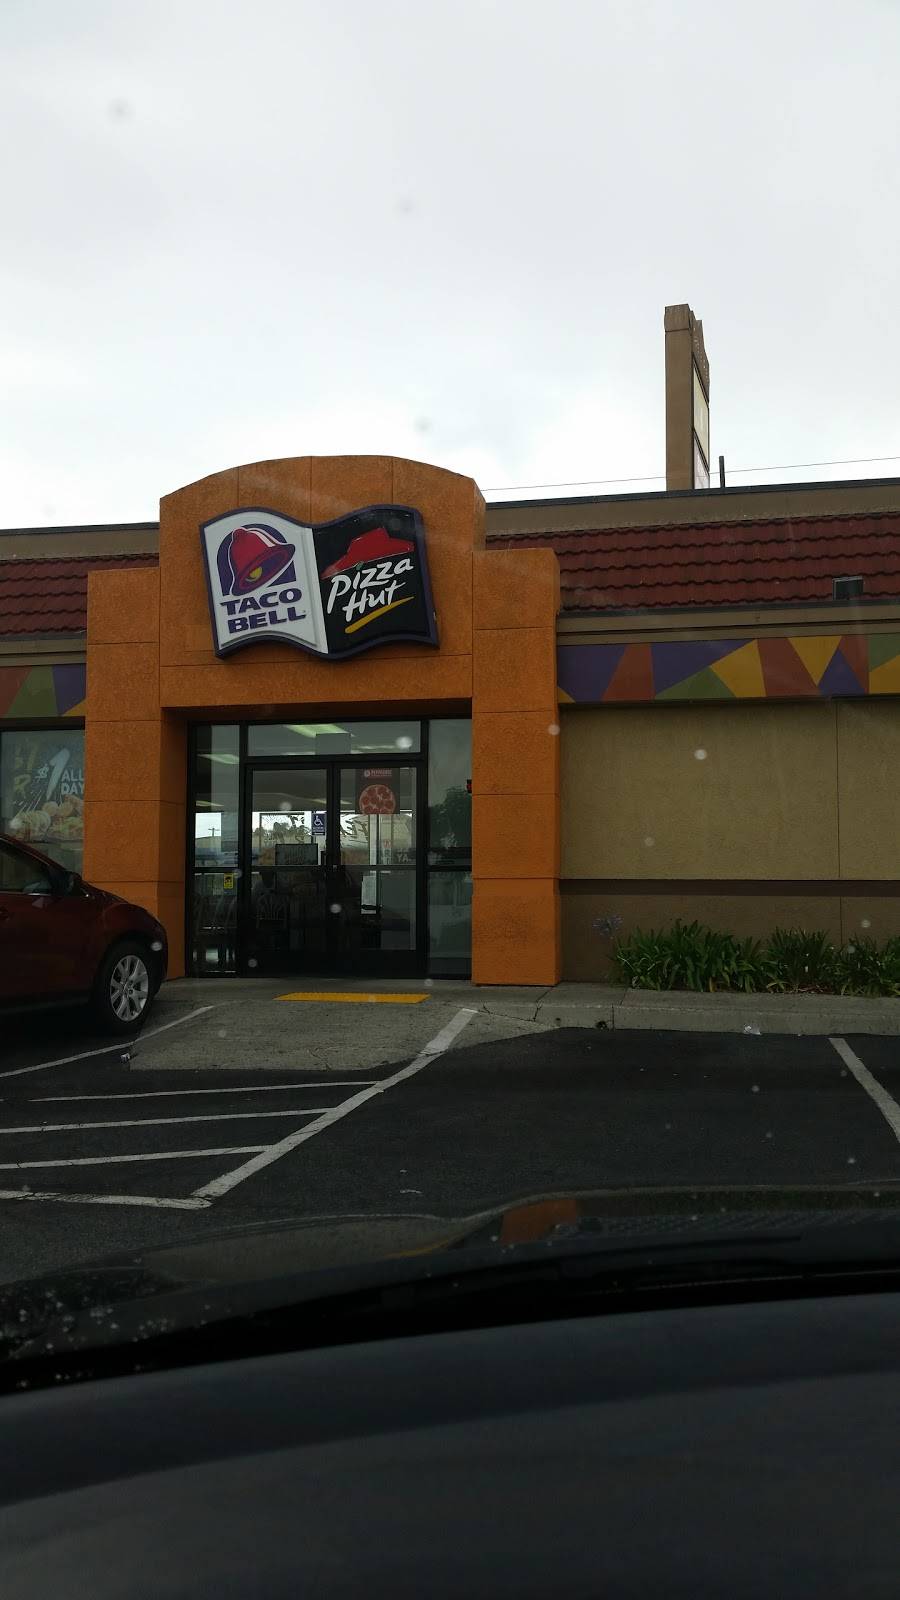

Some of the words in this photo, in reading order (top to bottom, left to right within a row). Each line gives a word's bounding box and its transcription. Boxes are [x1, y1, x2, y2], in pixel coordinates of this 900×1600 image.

[327, 558, 414, 614] Pizza
[220, 588, 302, 615] TACO
[343, 580, 406, 622] Hut
[227, 606, 306, 634] BELL
[62, 768, 84, 782] ALL
